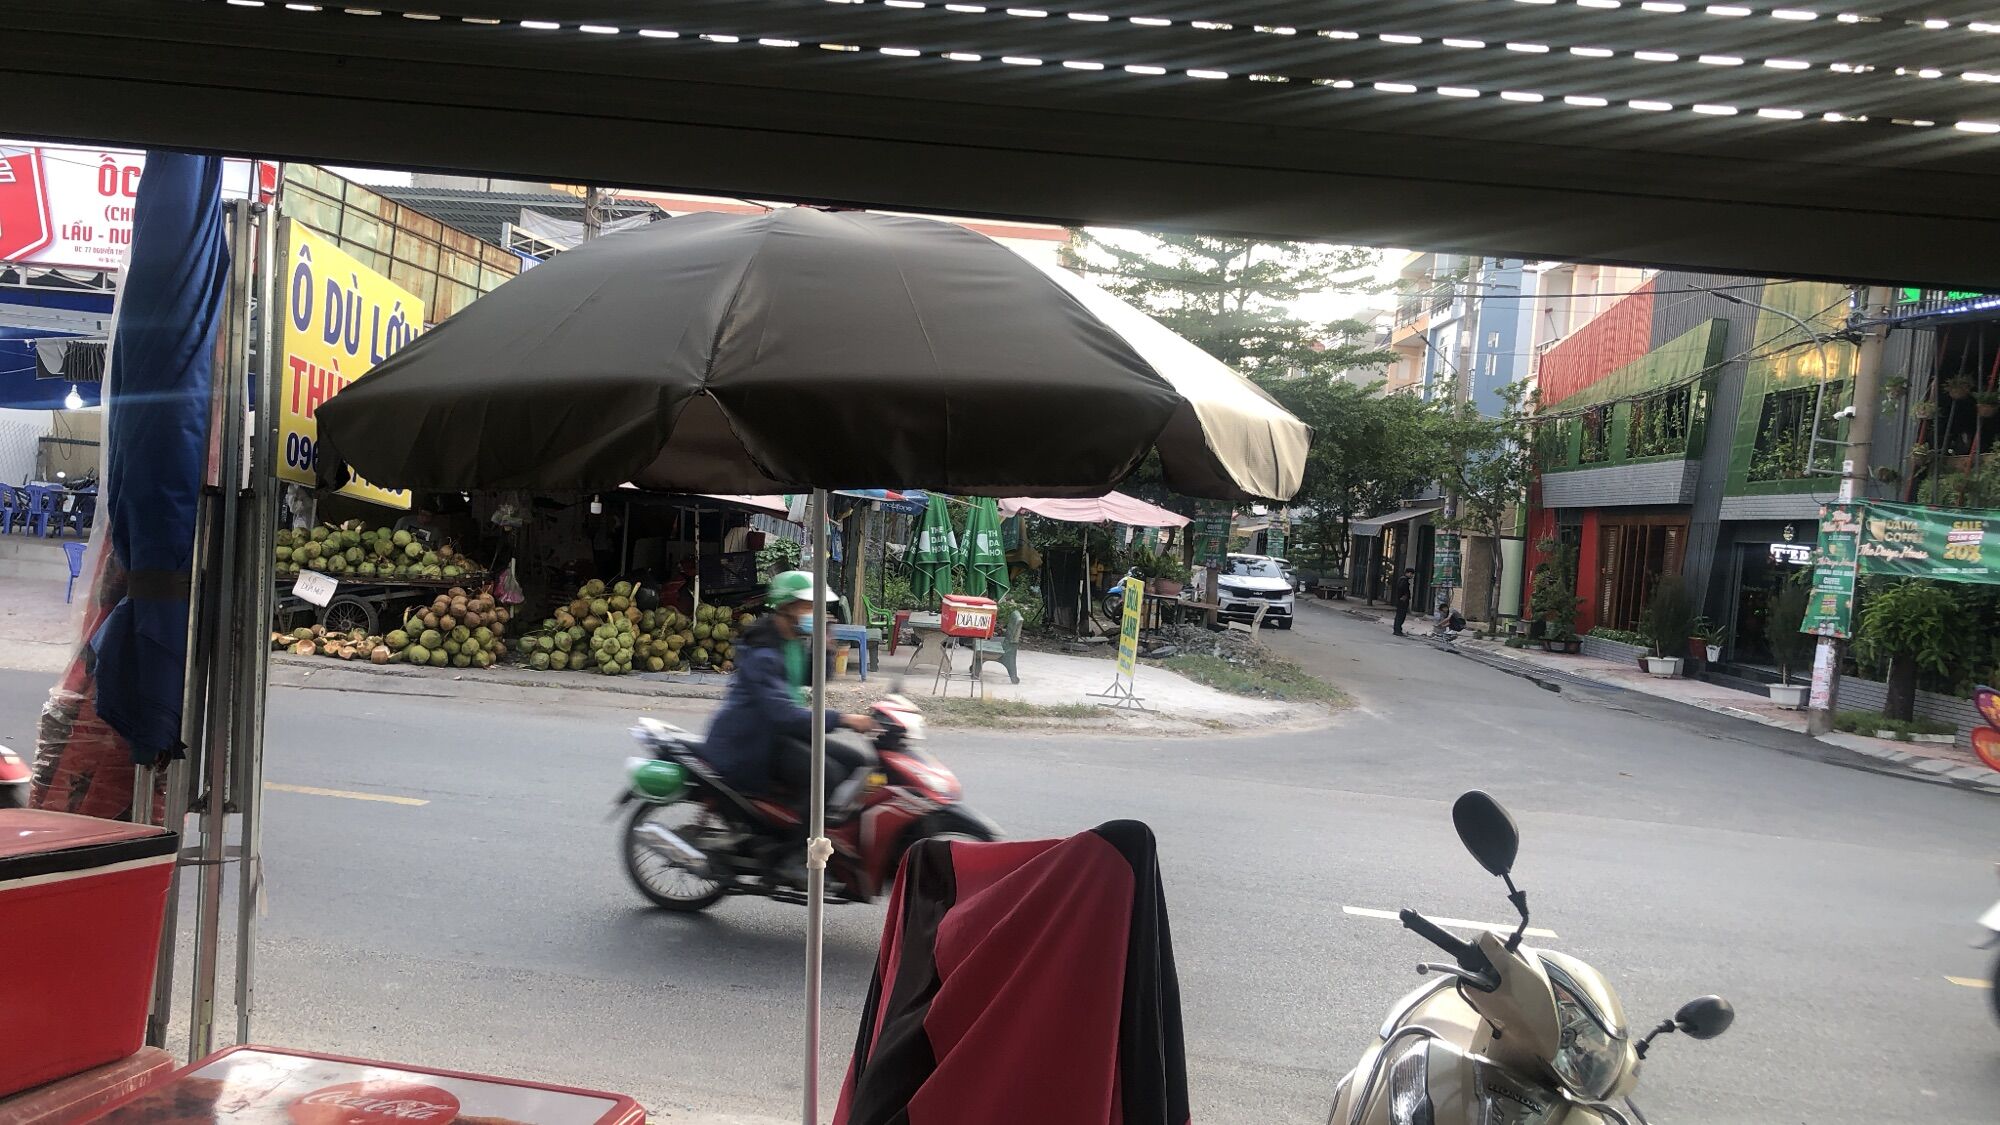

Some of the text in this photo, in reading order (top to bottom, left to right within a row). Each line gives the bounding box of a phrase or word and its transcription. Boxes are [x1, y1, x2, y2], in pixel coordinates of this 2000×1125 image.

[98, 154, 141, 197] ỐC
[292, 243, 419, 367] Ô DÙ LỚ
[1953, 520, 1983, 530] SALE
